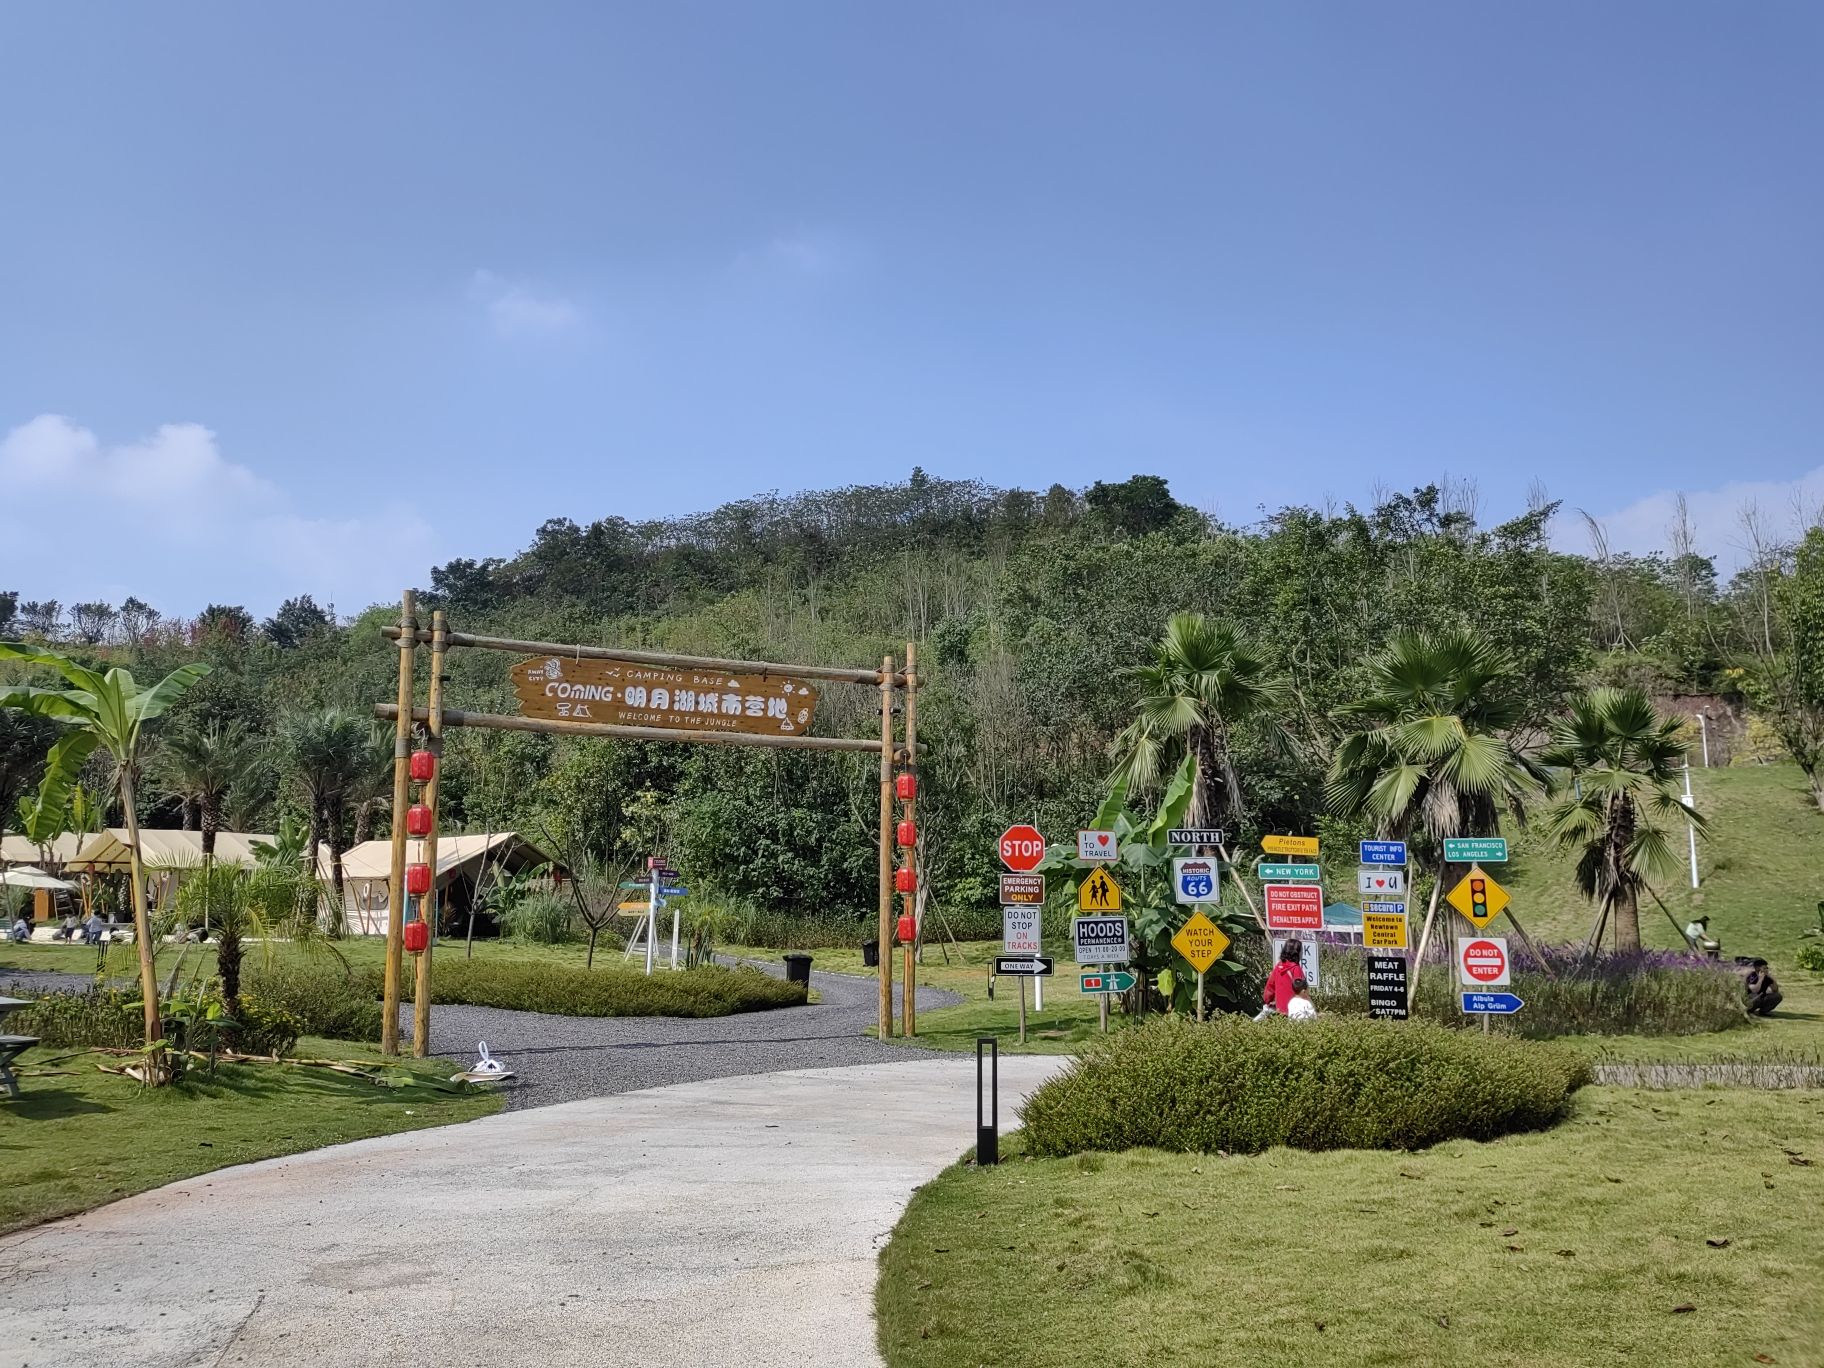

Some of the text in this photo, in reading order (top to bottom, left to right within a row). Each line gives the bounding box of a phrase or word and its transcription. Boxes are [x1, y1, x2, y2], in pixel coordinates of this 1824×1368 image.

[626, 669, 723, 685] CAMPING BASE
[624, 685, 788, 719] 明月湖城市营地
[618, 711, 737, 727] WELCOME TO THE JUNGLE
[1171, 831, 1220, 843] NORTH
[1003, 840, 1042, 857] STOP
[1389, 845, 1403, 853] INFO
[1372, 853, 1396, 861] CENTER
[1295, 868, 1315, 876] YORK
[1003, 877, 1042, 885] EMERGENCY
[1365, 876, 1371, 889] I
[1004, 885, 1039, 893] PARKING
[1188, 881, 1208, 895] 66
[1270, 890, 1278, 898] DO
[1290, 891, 1318, 899] OBSTRUCT
[1272, 903, 1318, 912] FIRE EXIT PATH
[1397, 904, 1404, 912] P
[1007, 911, 1037, 919] DO NOT
[1272, 915, 1318, 925] PENALTIES APPLY
[1011, 921, 1033, 930] STOP
[1079, 922, 1123, 938] HOODS
[1016, 931, 1028, 940] ON
[1185, 928, 1215, 937] WATCH
[1007, 941, 1038, 950] TRACKS
[1188, 938, 1213, 947] YOUR
[1190, 949, 1212, 958] STEP
[1469, 948, 1498, 956] DO NOT
[1374, 961, 1399, 970] MEAT
[1472, 967, 1499, 975] ENTER
[1370, 972, 1405, 981] RAFFLE
[1370, 984, 1393, 992] FRIDAY
[1370, 999, 1397, 1007] BINGO
[1487, 1002, 1507, 1010] Grüm
